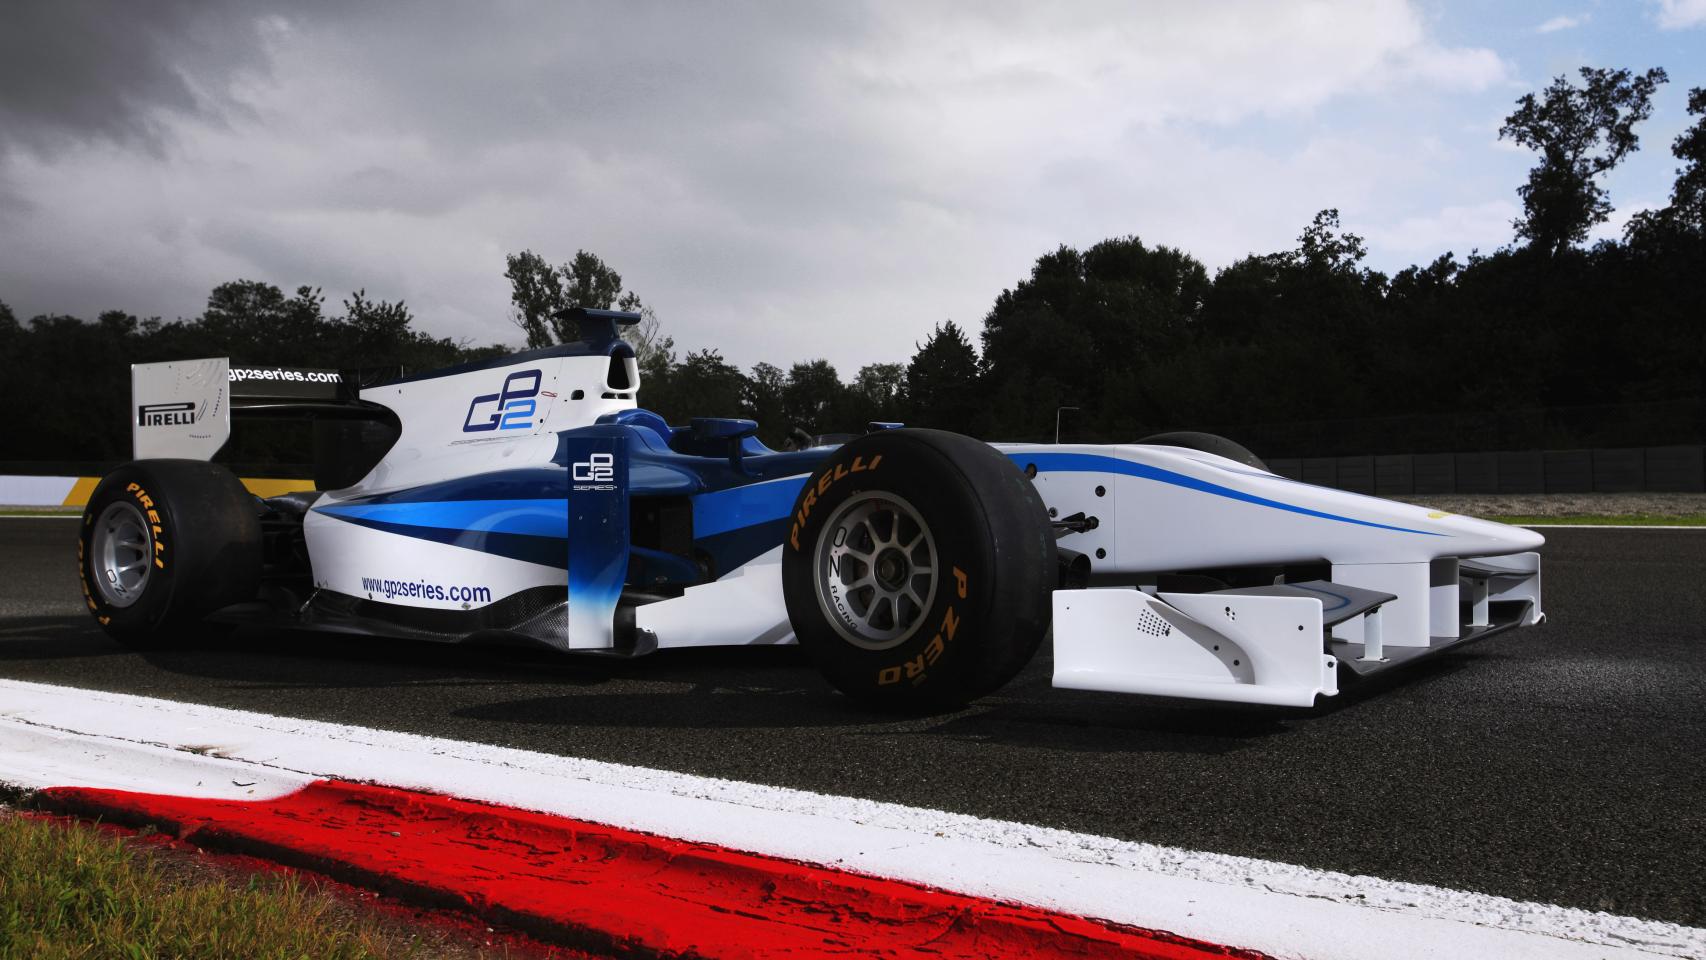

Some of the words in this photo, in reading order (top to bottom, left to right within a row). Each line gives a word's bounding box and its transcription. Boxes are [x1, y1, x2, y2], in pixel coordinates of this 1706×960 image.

[138, 402, 196, 427] PIRELLI
[126, 482, 164, 569] PIRELLI
[790, 455, 882, 551] PIRELLI
[361, 576, 492, 603] www.gp2series.com
[953, 566, 967, 599] P
[830, 585, 859, 630] RACING
[878, 607, 959, 685] ZERO
